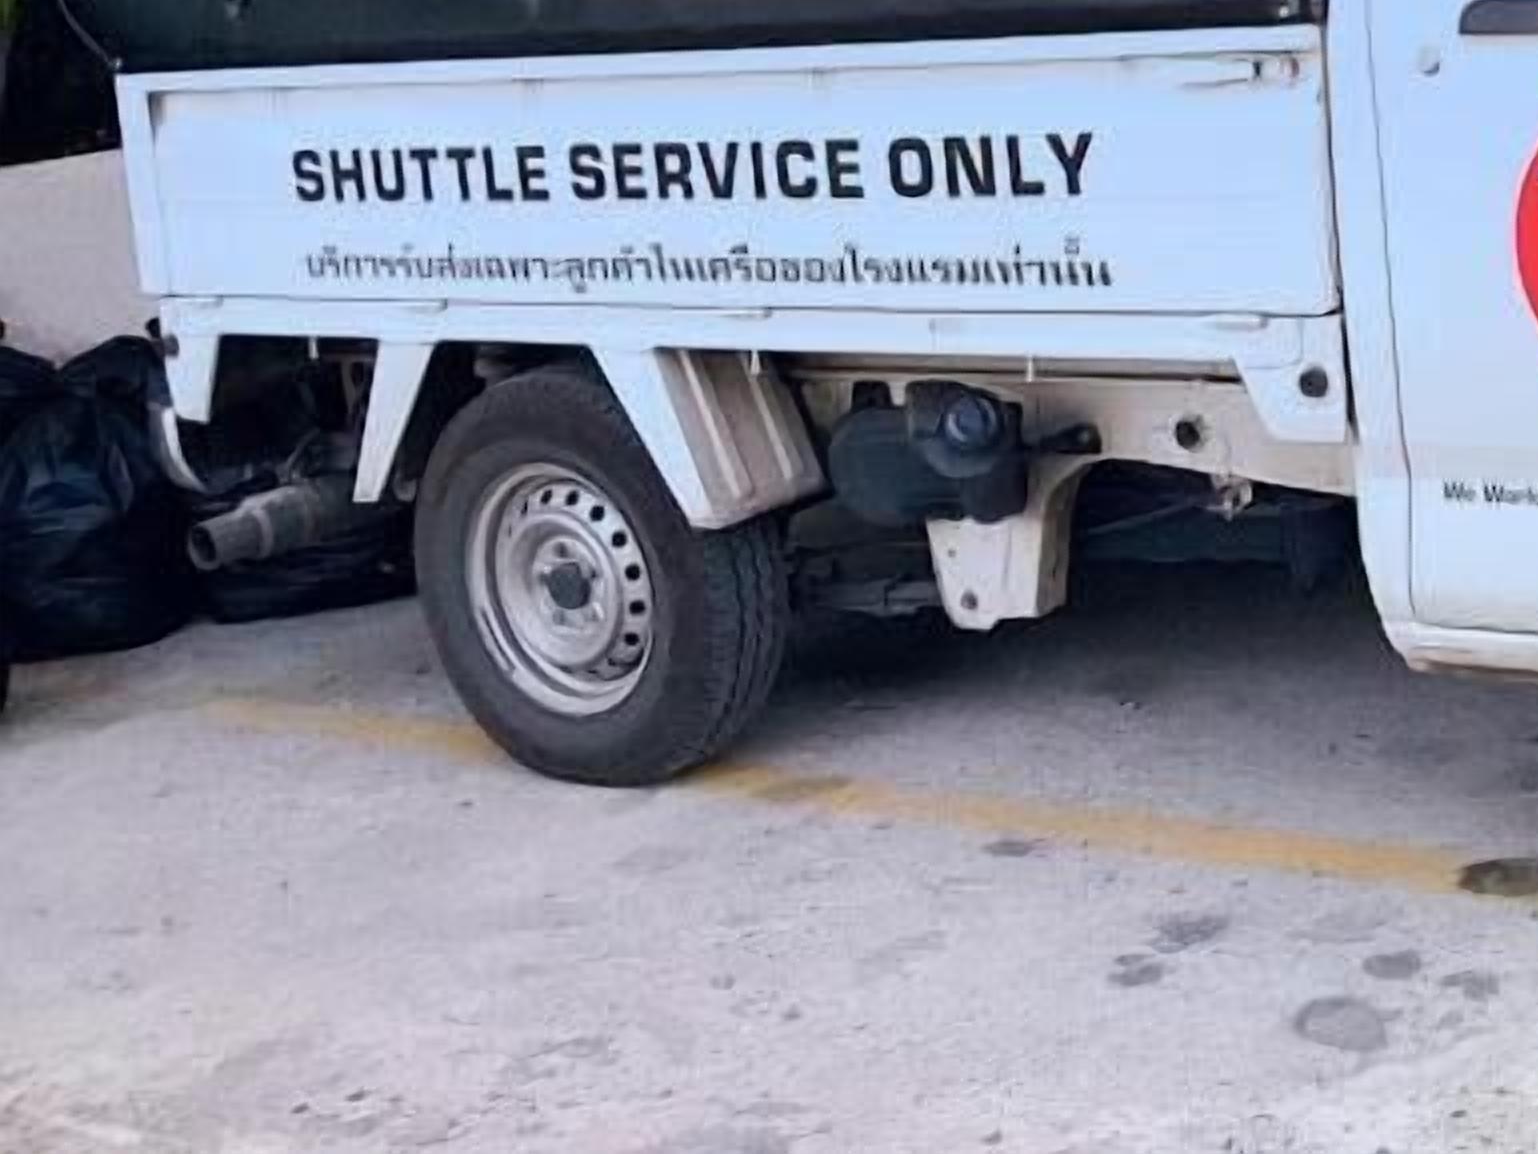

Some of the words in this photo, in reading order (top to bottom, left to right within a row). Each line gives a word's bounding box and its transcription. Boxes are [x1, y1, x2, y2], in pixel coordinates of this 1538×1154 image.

[292, 145, 551, 203] SHUTTLE
[568, 139, 864, 200] SERVICE
[888, 132, 1093, 198] ONLY
